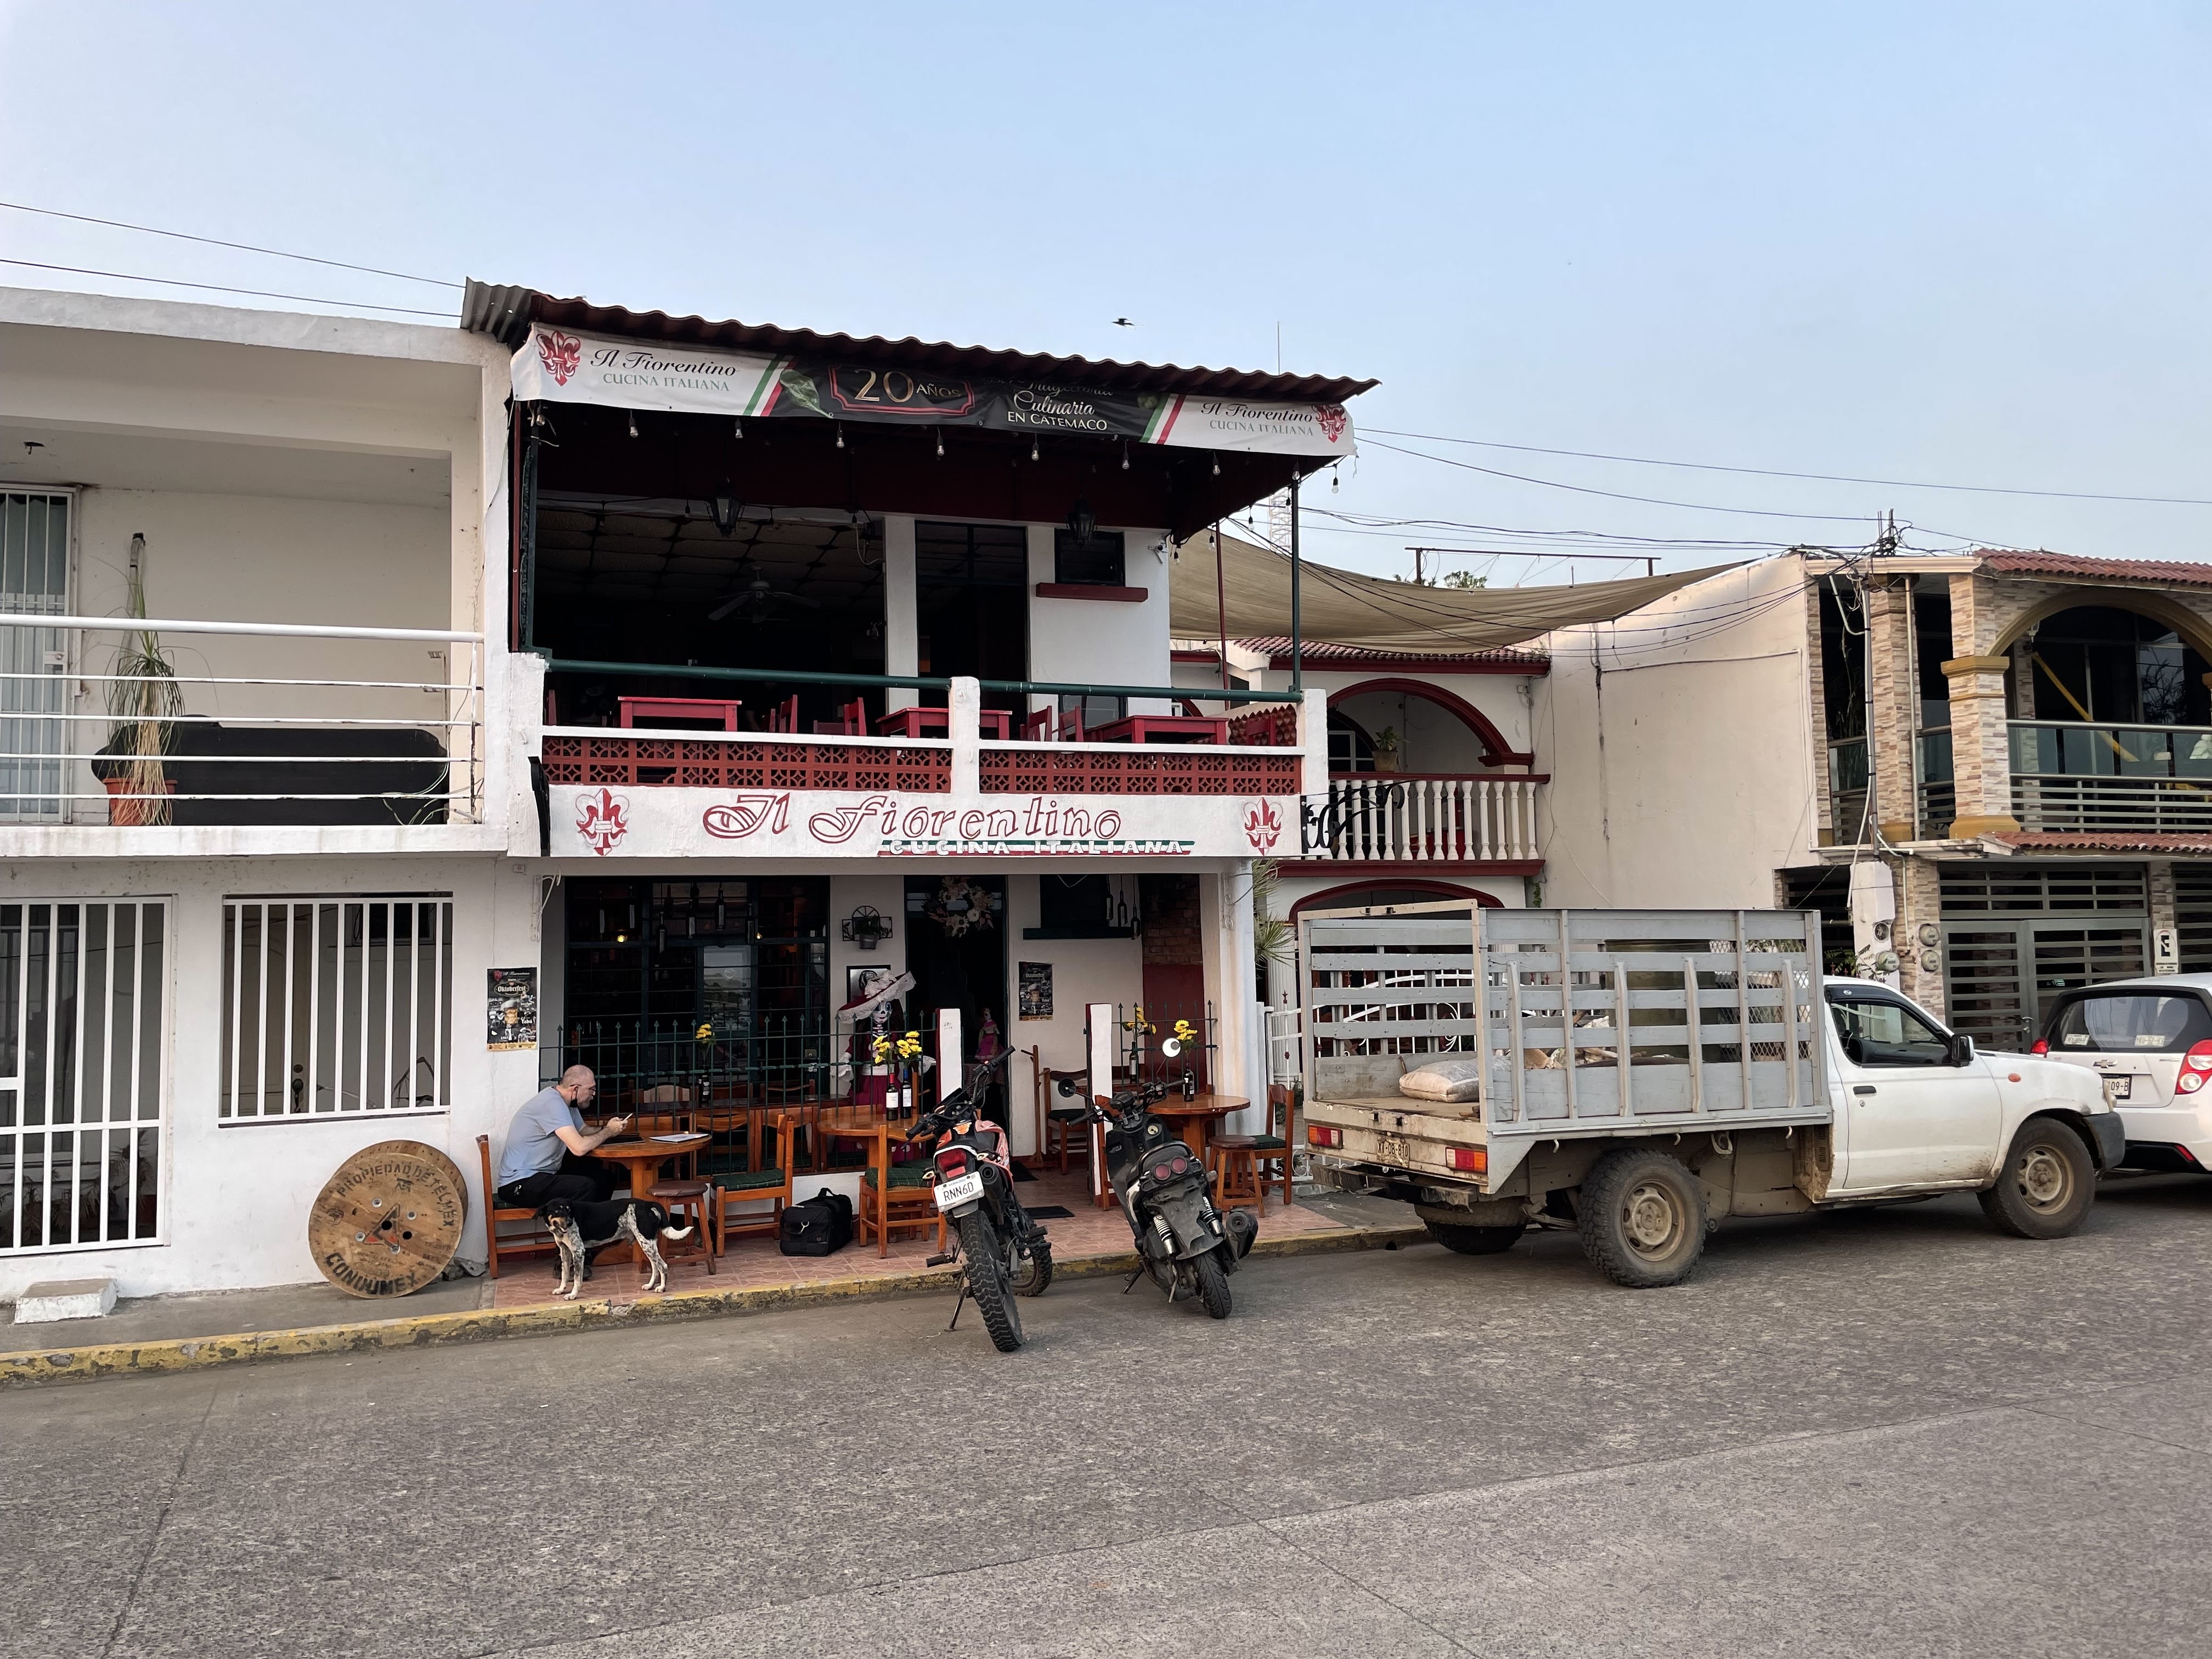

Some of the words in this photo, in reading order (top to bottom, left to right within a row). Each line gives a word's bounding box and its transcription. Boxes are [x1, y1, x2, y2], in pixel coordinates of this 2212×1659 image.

[590, 348, 620, 367] Il
[623, 351, 738, 376] Fiorentino
[602, 373, 659, 386] CUCINA
[664, 377, 730, 392] ITALIANA
[854, 368, 914, 403] 20
[916, 383, 962, 397] AÑOS
[1013, 390, 1095, 415] Culinaria
[1201, 402, 1221, 416] Il
[1225, 403, 1313, 423] Fiorentino
[1008, 411, 1025, 423] EN
[1030, 414, 1108, 431] CATEMACO
[1210, 420, 1255, 432] CUCINA
[1259, 424, 1314, 437] ITALIANA
[703, 793, 790, 839] Il
[809, 795, 1122, 844] Fiorentino
[889, 839, 1011, 855] CUCINA
[1034, 840, 1183, 855] ITALIANA
[2111, 1081, 2129, 1092] 09-B
[337, 1164, 411, 1197] PROPIEDAD
[413, 1165, 435, 1182] DE
[430, 1177, 457, 1227] TELMEX
[943, 1182, 974, 1202] RNN6D
